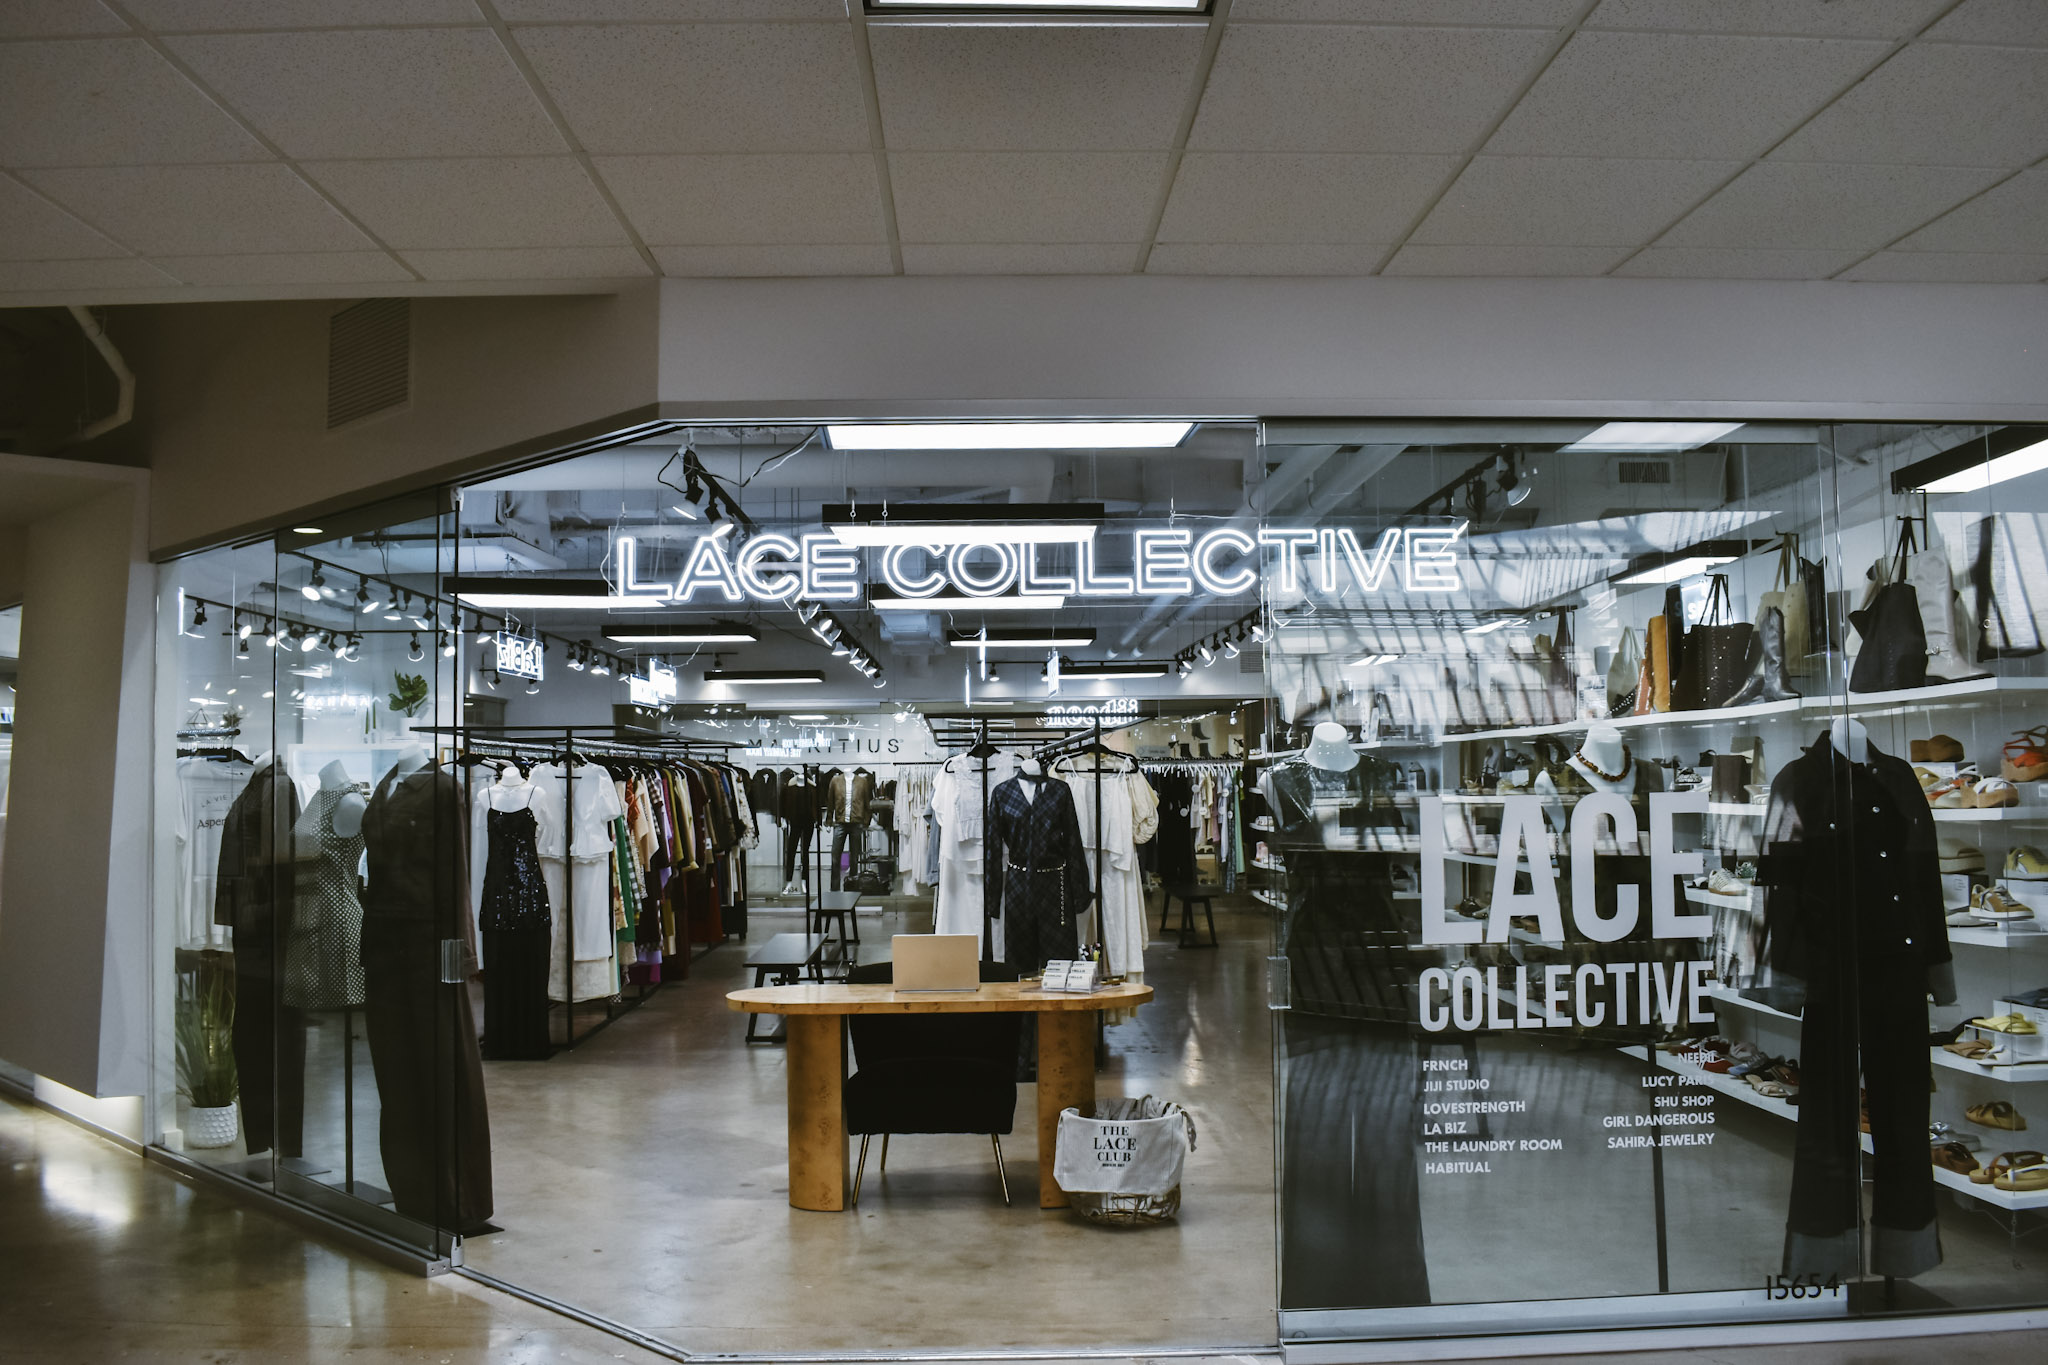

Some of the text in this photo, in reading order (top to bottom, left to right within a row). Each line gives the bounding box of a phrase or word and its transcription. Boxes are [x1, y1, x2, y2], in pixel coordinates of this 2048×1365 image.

[617, 527, 1461, 601] LACE COLLECTIVE
[748, 738, 900, 753] MATIUS
[1420, 791, 1714, 945] LACE
[1418, 959, 1716, 1032] COLLECTIVE
[1422, 1059, 1468, 1072] FRNCH
[1423, 1078, 1490, 1092] JIJI STUDIO
[1642, 1073, 1715, 1088] LUCY PARIS
[1423, 1100, 1526, 1115] LOVESTRENGTH
[1654, 1094, 1715, 1108] SHU SHOP
[1602, 1112, 1716, 1128] GIRL DANGEROUS
[1100, 1125, 1130, 1136] THE
[1424, 1121, 1467, 1136] LA BIZ
[1093, 1137, 1137, 1151] LACE
[1424, 1138, 1563, 1153] THE LAUNDRY ROOM
[1607, 1132, 1715, 1149] SAHIRA JEWELRY
[1097, 1151, 1131, 1162] CLUB
[1425, 1161, 1492, 1175] HABITUAL
[1766, 1272, 1840, 1301] 15654
